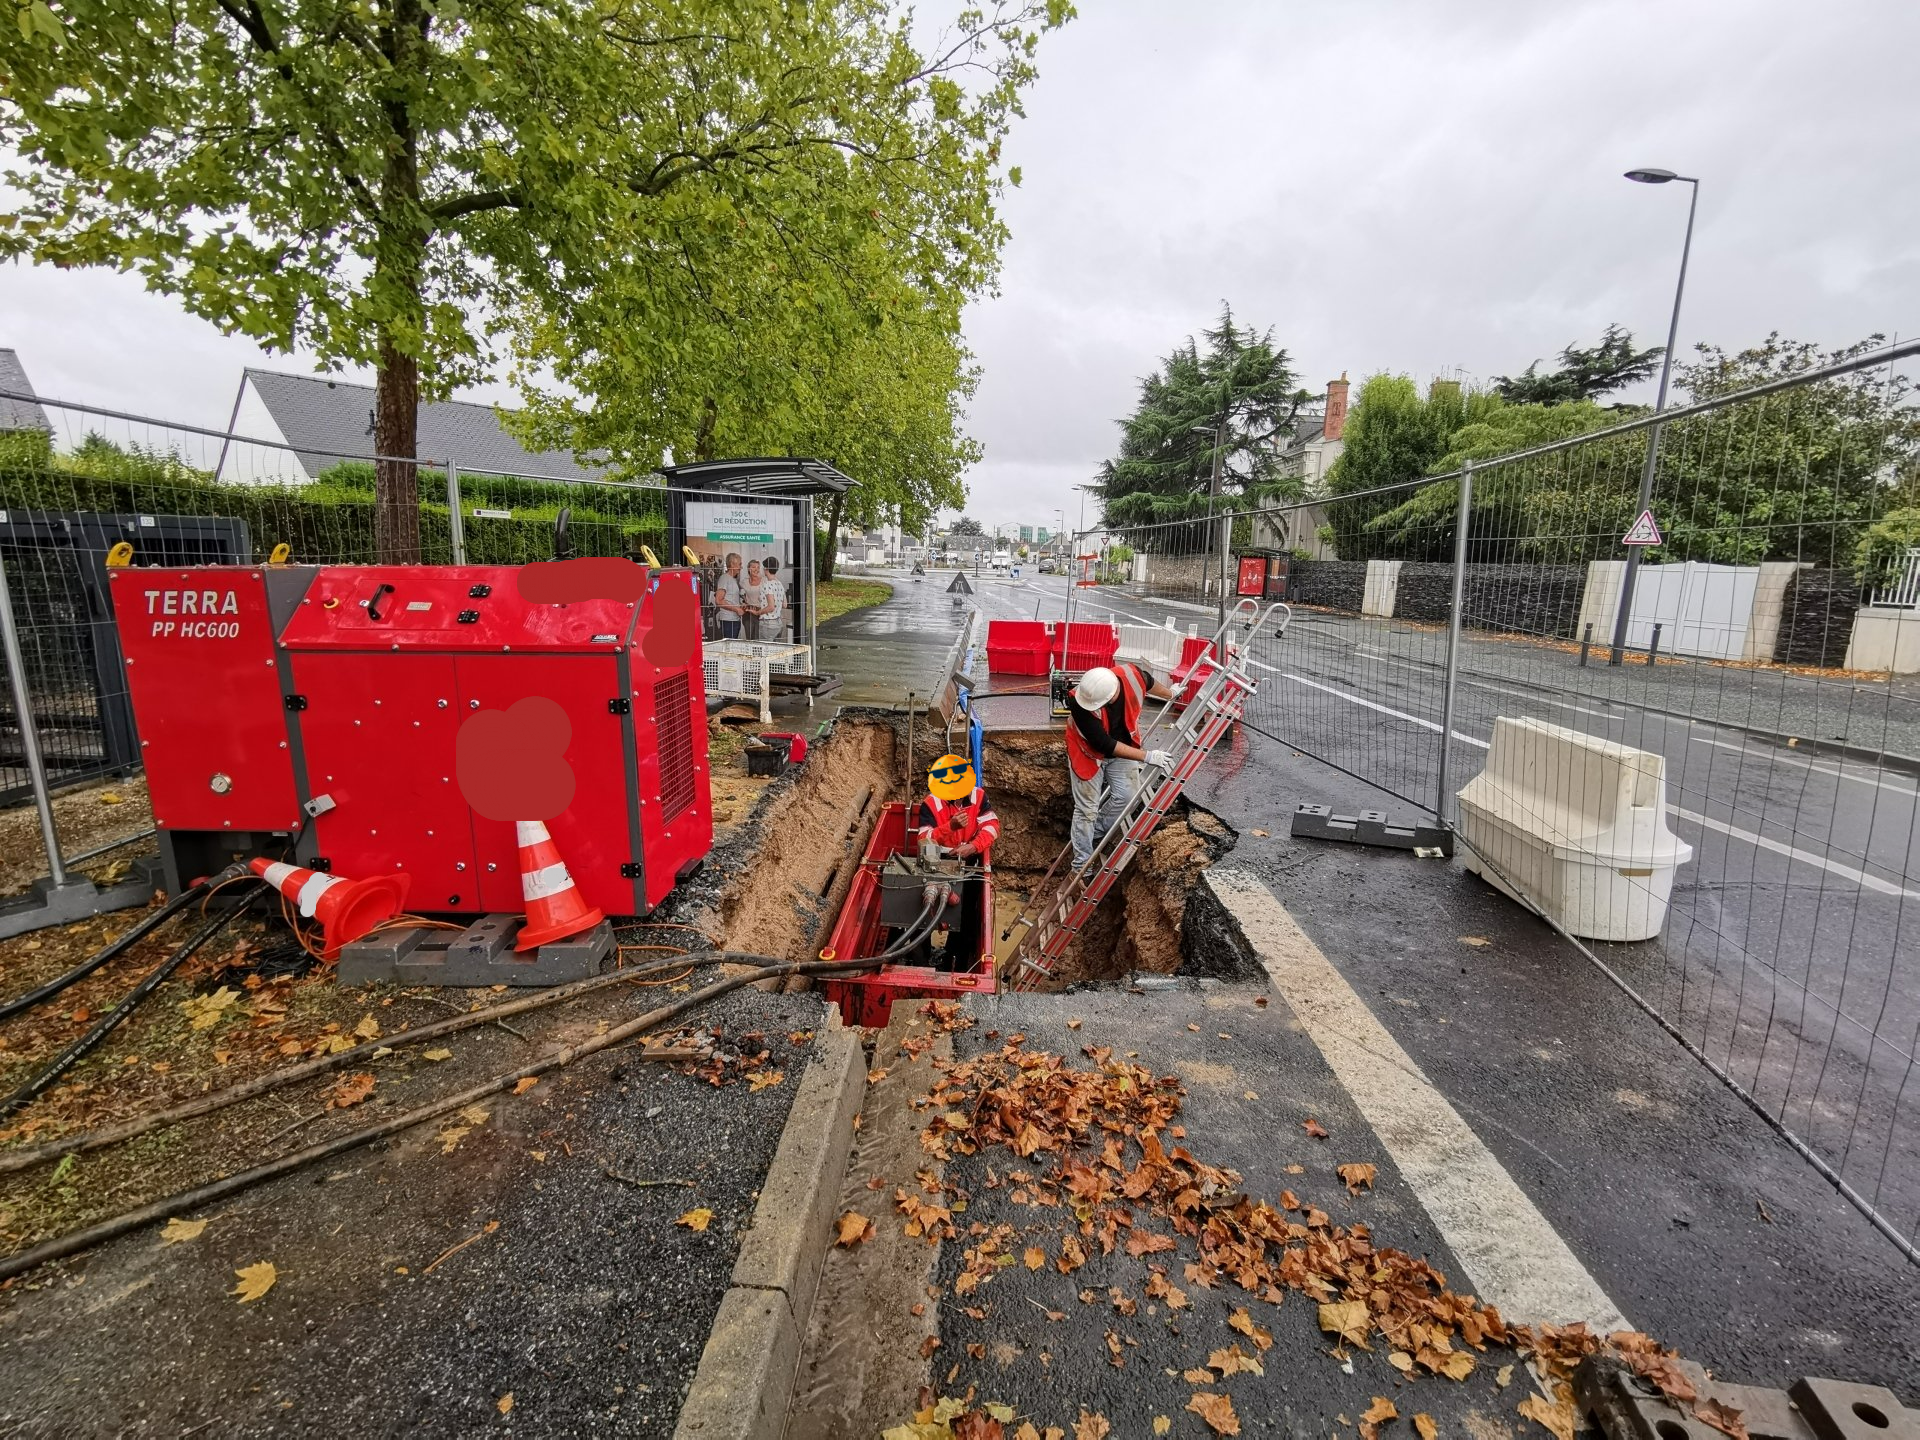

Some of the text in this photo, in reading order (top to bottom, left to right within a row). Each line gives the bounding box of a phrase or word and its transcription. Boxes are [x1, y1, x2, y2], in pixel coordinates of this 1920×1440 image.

[725, 517, 767, 525] RÉDUCTION
[144, 590, 239, 615] TERRA
[152, 622, 240, 638] PP HC600
